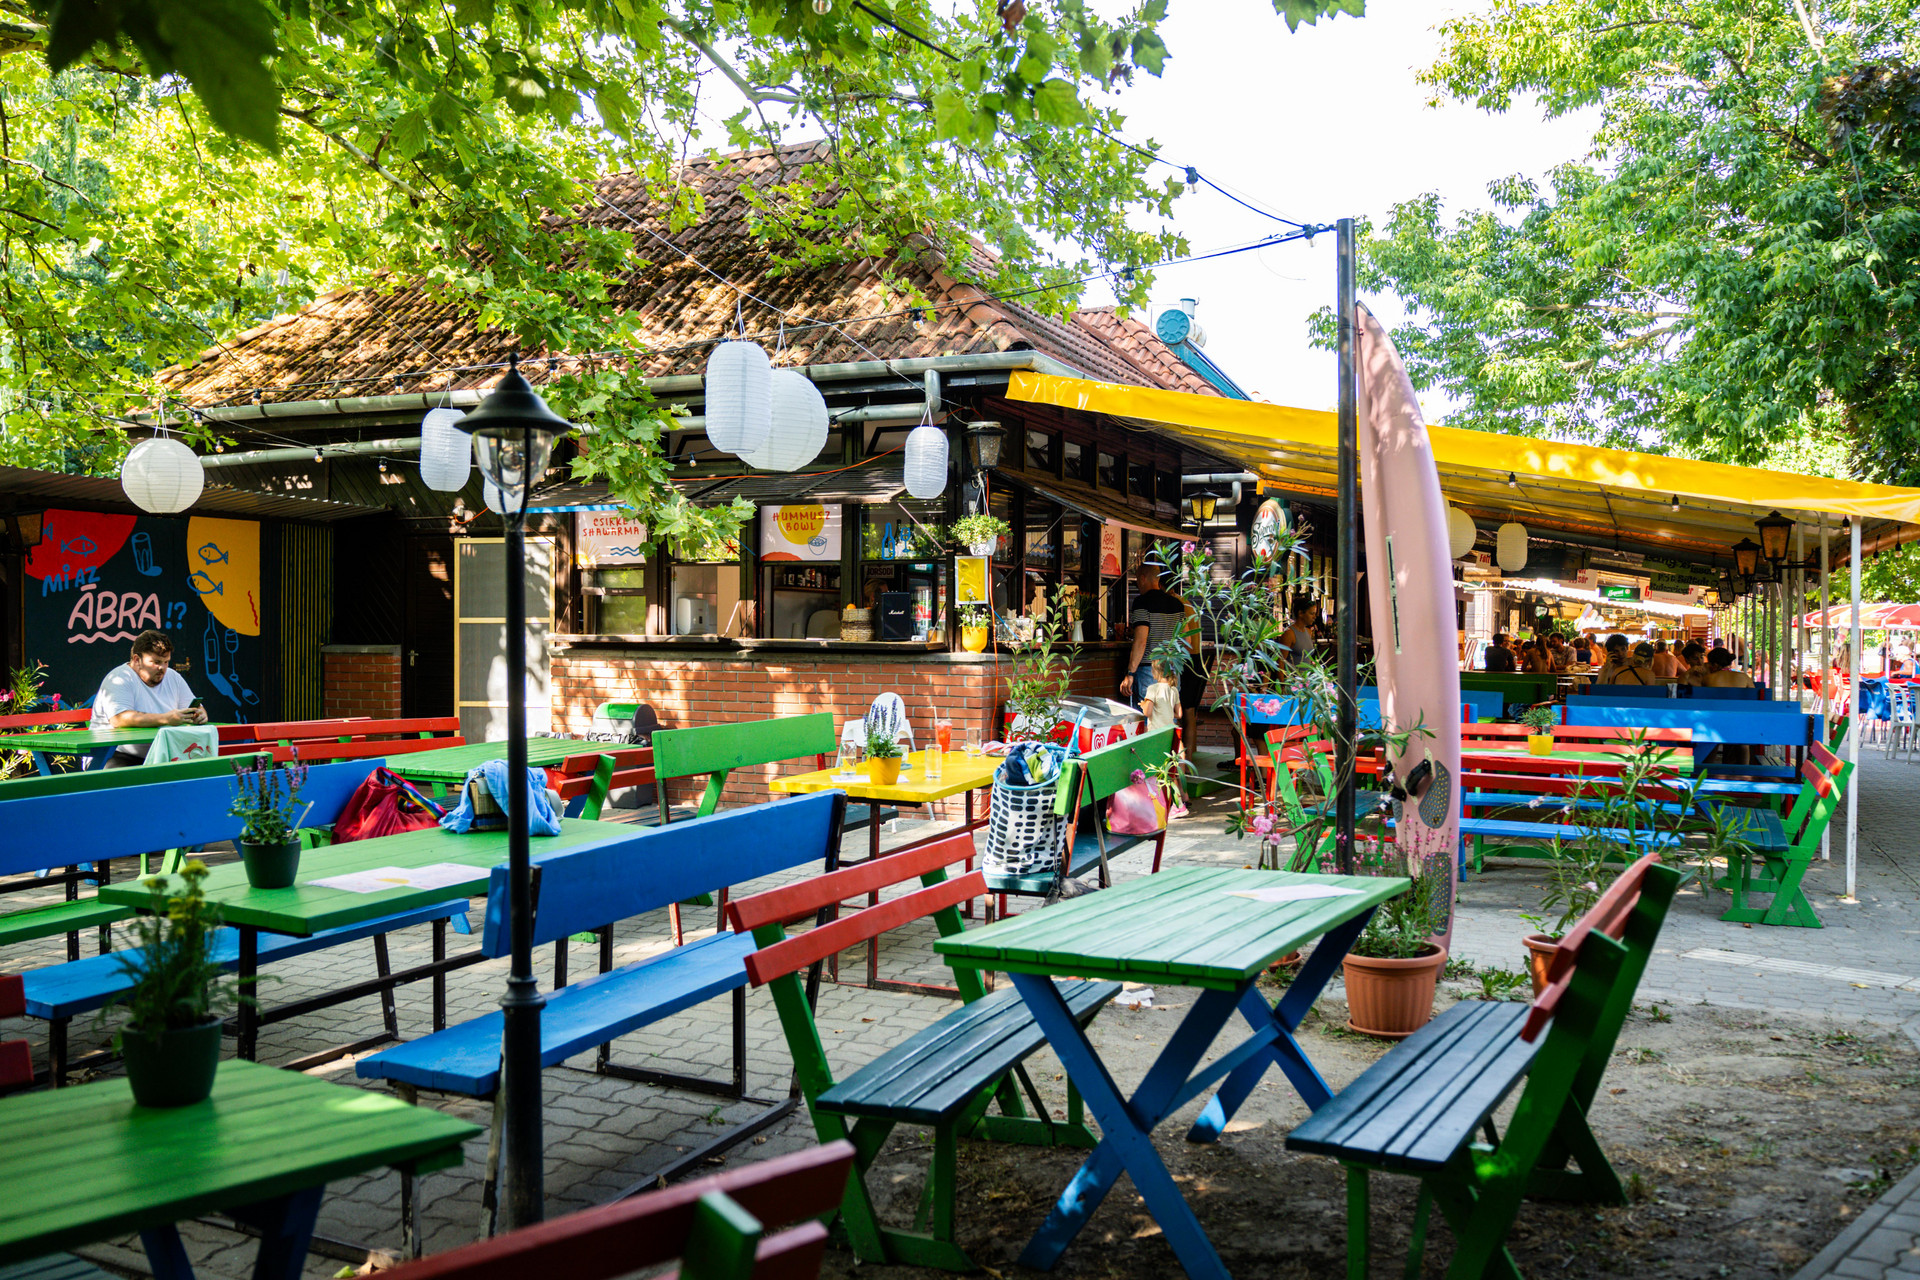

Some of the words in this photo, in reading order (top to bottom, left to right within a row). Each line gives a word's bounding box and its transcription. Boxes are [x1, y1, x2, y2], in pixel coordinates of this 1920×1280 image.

[772, 510, 831, 521] HUMMUSZ
[593, 517, 628, 527] CSIRKE
[786, 522, 816, 531] BOWL
[582, 526, 640, 537] SHAWARMA
